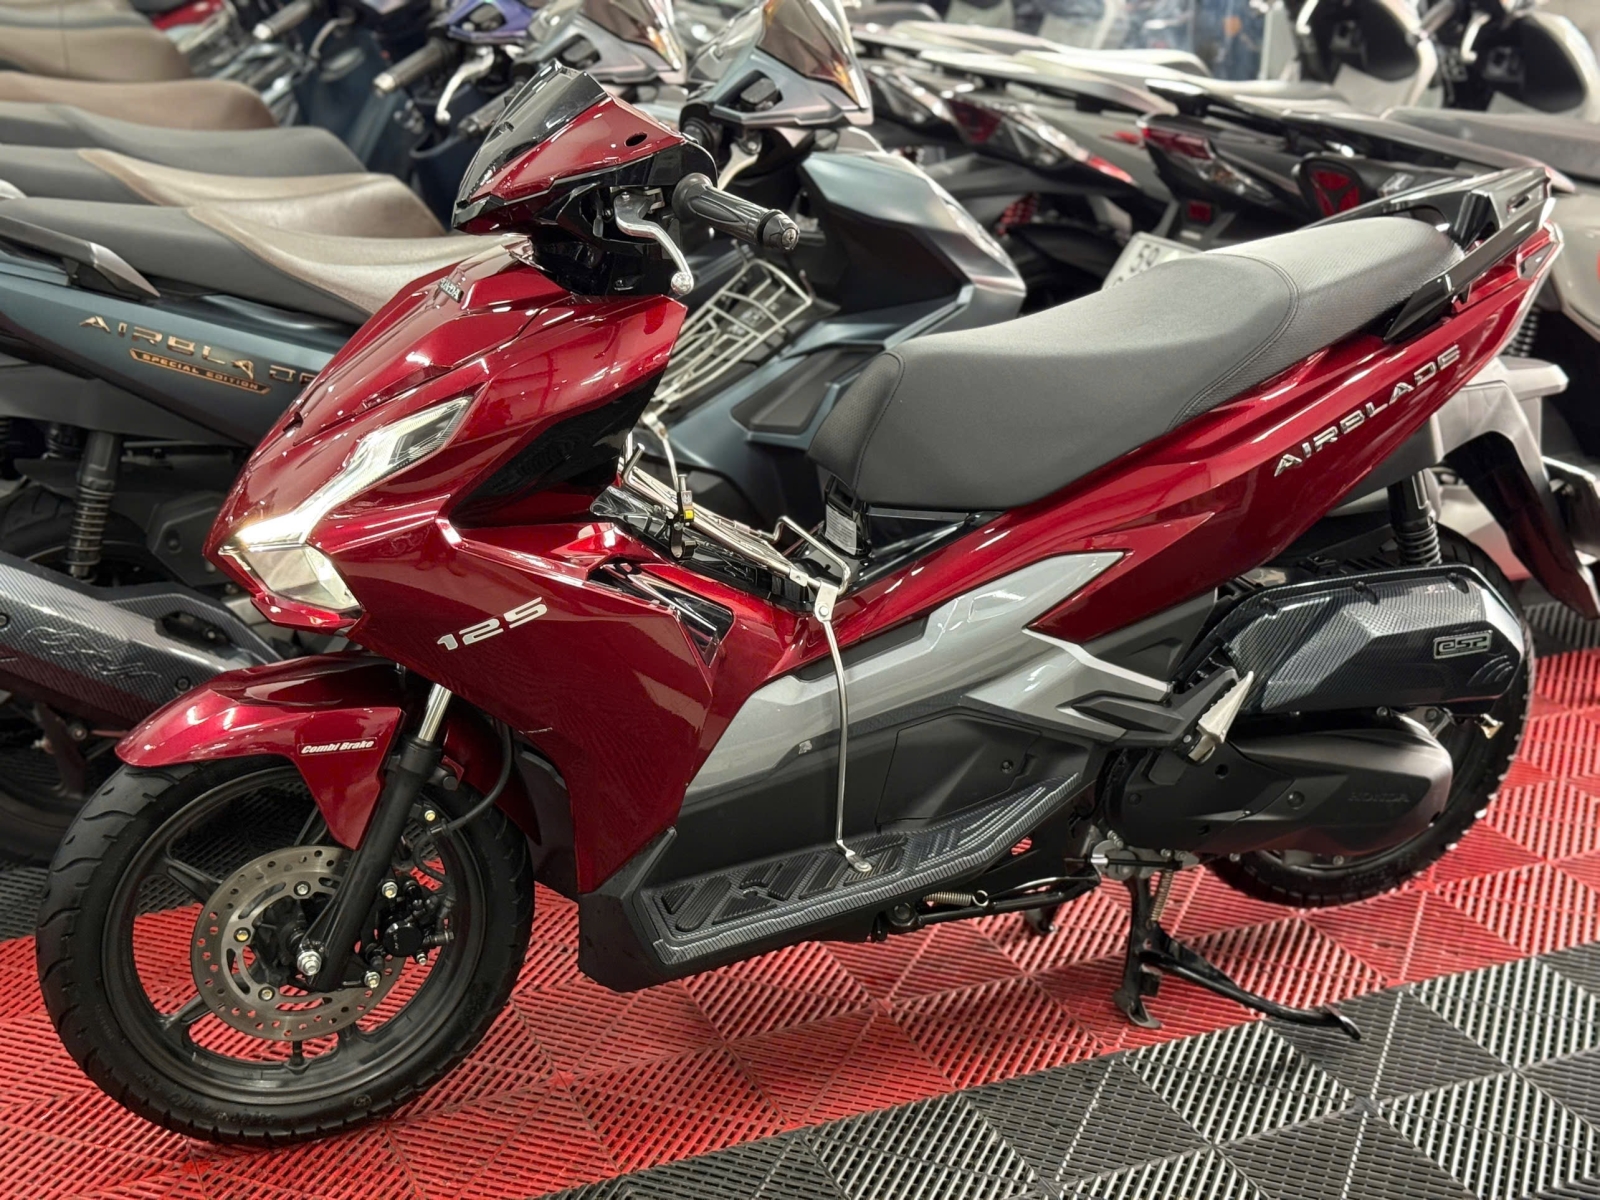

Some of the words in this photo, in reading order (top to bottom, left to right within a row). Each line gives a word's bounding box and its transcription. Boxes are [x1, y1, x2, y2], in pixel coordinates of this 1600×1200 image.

[142, 353, 200, 374] SPECIAL
[205, 371, 258, 390] EDITION
[1274, 344, 1461, 477] AIRBLADE
[437, 597, 548, 650] 125
[301, 743, 341, 754] Combi
[339, 740, 375, 751] Brake
